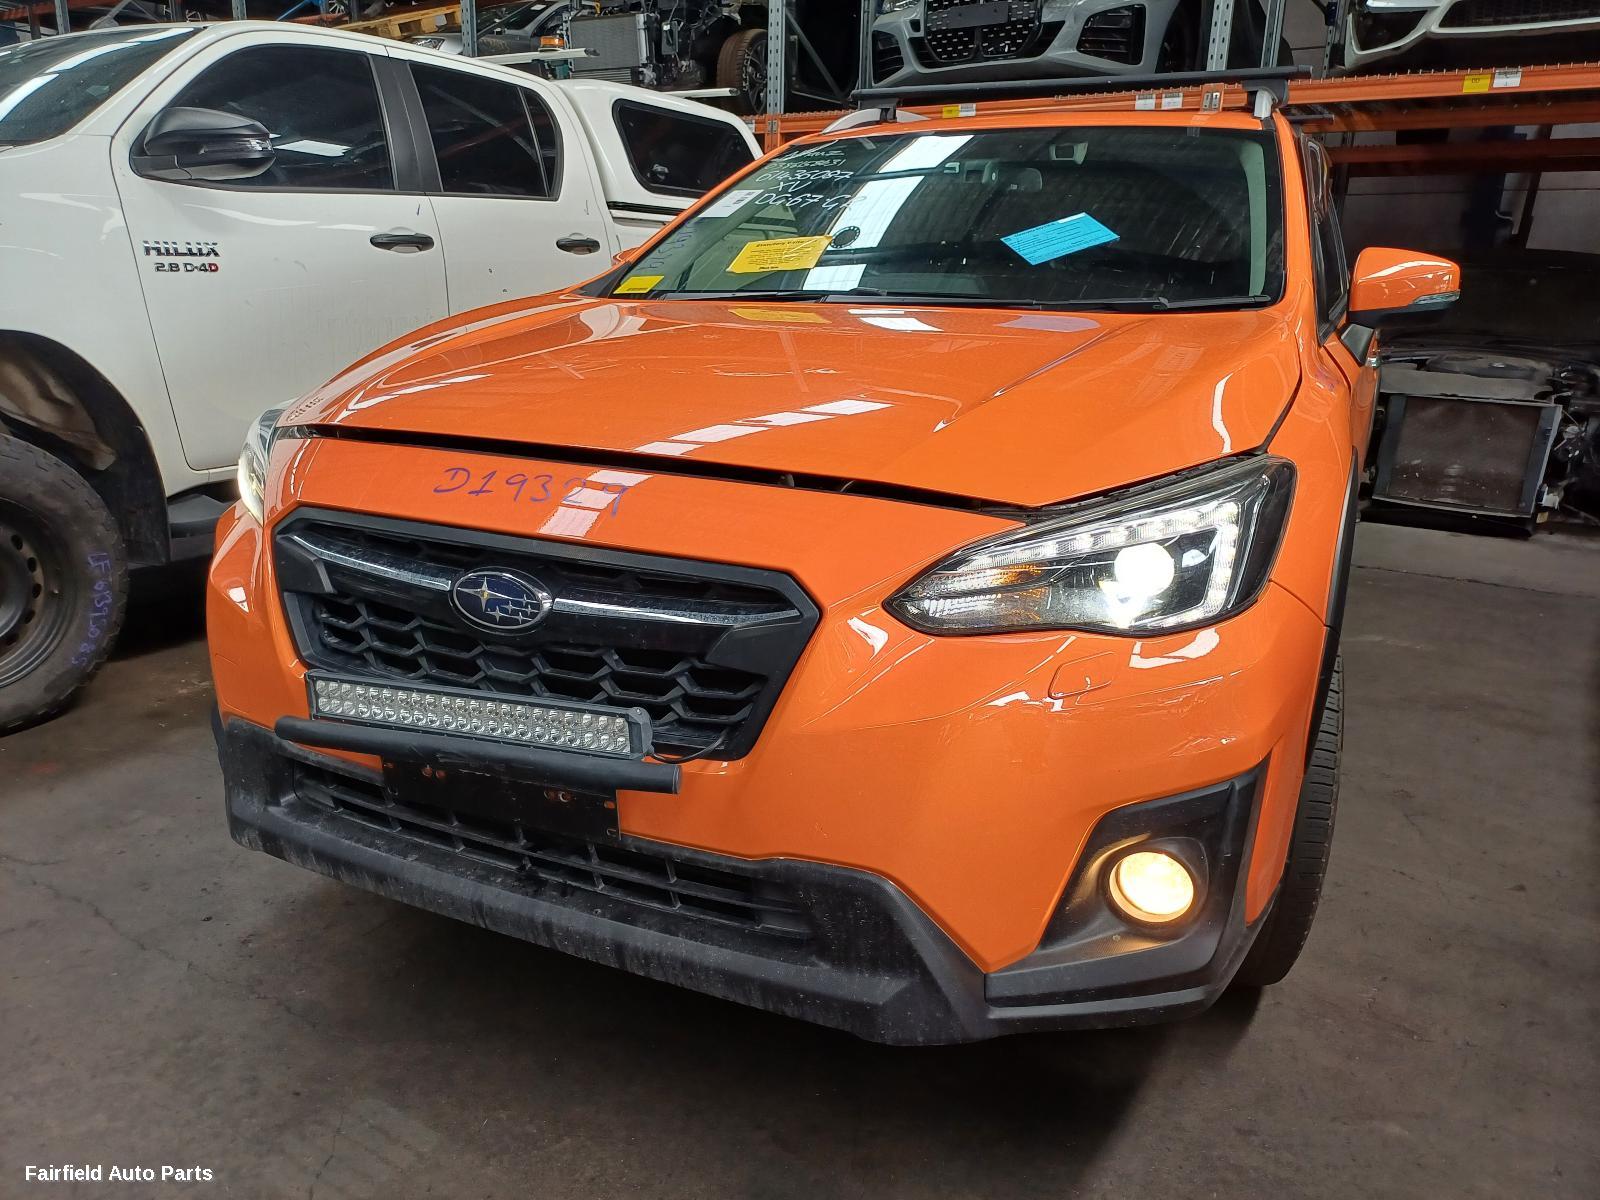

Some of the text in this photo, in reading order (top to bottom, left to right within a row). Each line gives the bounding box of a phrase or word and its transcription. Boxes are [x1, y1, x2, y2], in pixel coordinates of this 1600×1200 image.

[142, 240, 220, 257] HILUX
[154, 262, 180, 272] 2.8
[432, 467, 630, 518] D19329
